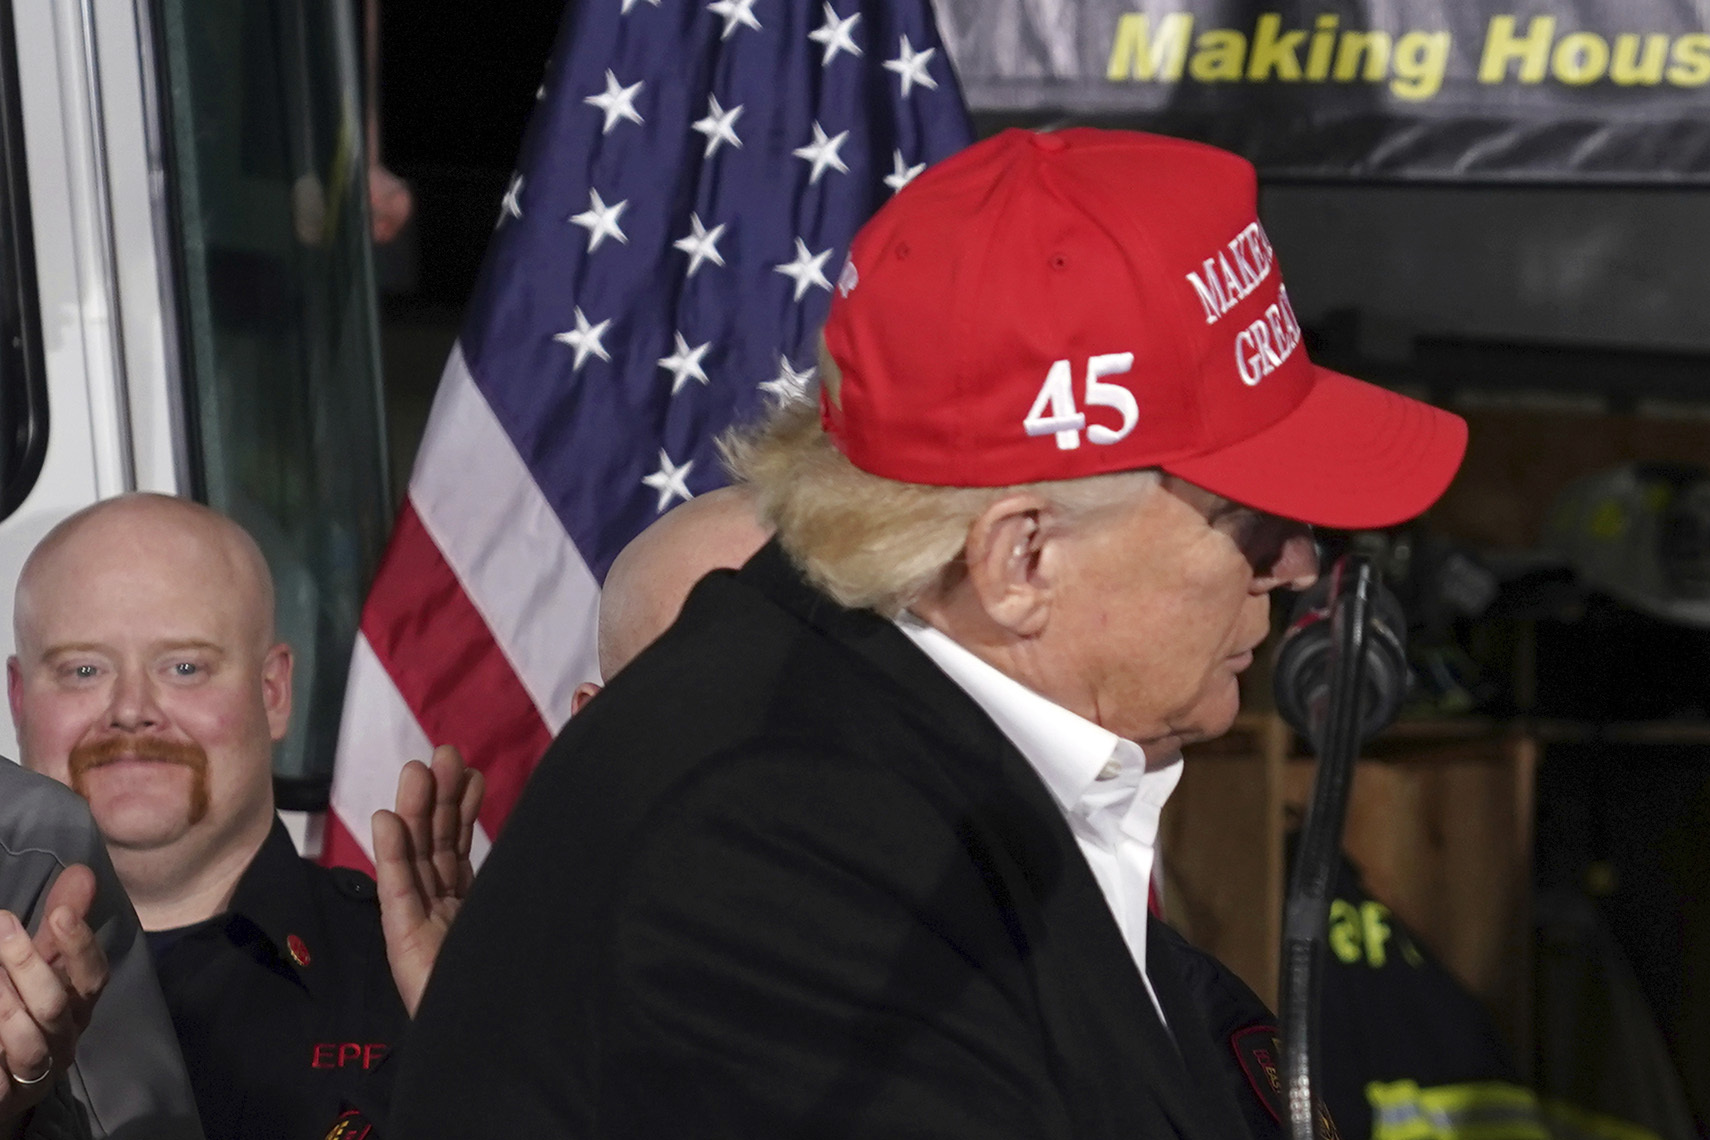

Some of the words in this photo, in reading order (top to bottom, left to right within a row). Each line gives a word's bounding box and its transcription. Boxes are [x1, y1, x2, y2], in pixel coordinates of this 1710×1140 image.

[1107, 13, 1449, 101] Making
[1185, 221, 1272, 325] MAKE
[1022, 351, 1140, 451] 45
